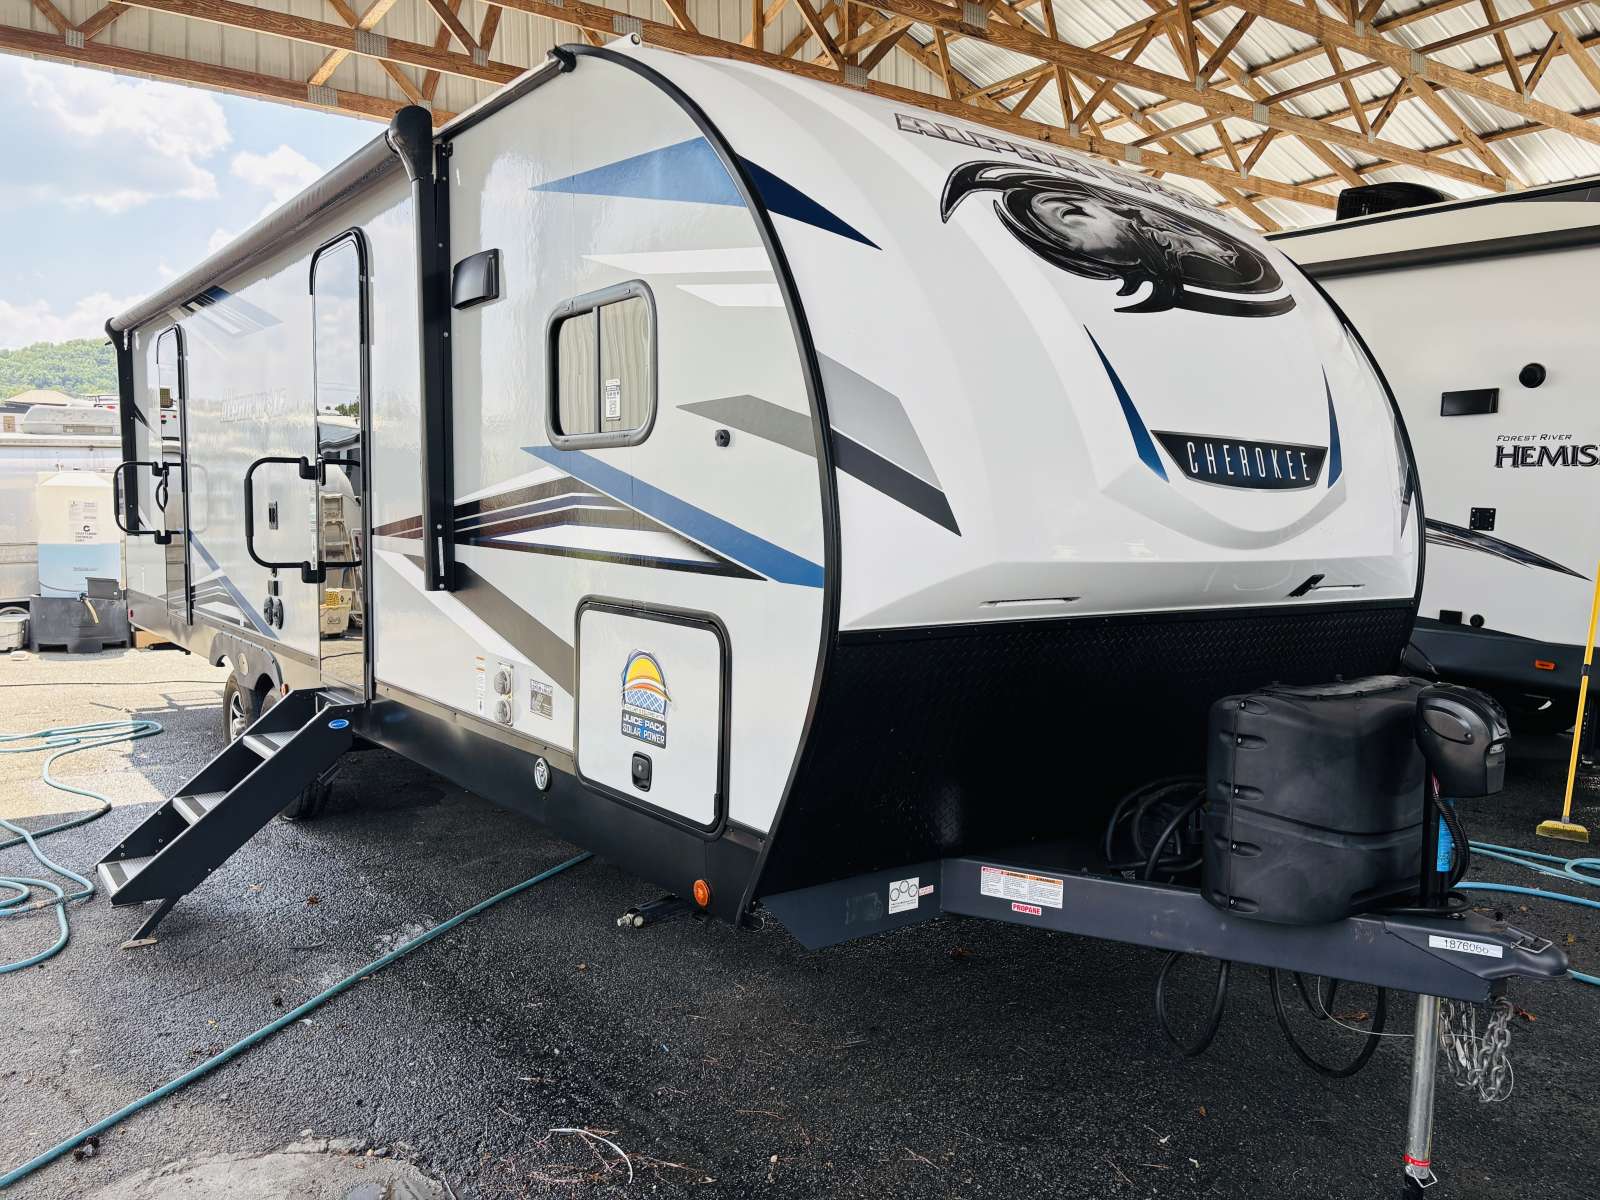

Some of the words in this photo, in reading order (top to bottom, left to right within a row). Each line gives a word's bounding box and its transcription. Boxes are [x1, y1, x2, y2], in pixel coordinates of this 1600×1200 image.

[1186, 441, 1311, 481] CHEROKEE
[1494, 444, 1600, 468] HEMIS
[622, 723, 642, 737] SOLAR
[643, 729, 665, 745] POWER
[623, 714, 643, 727] JUICE
[644, 719, 665, 734] PACK
[1012, 903, 1041, 915] PROPANE
